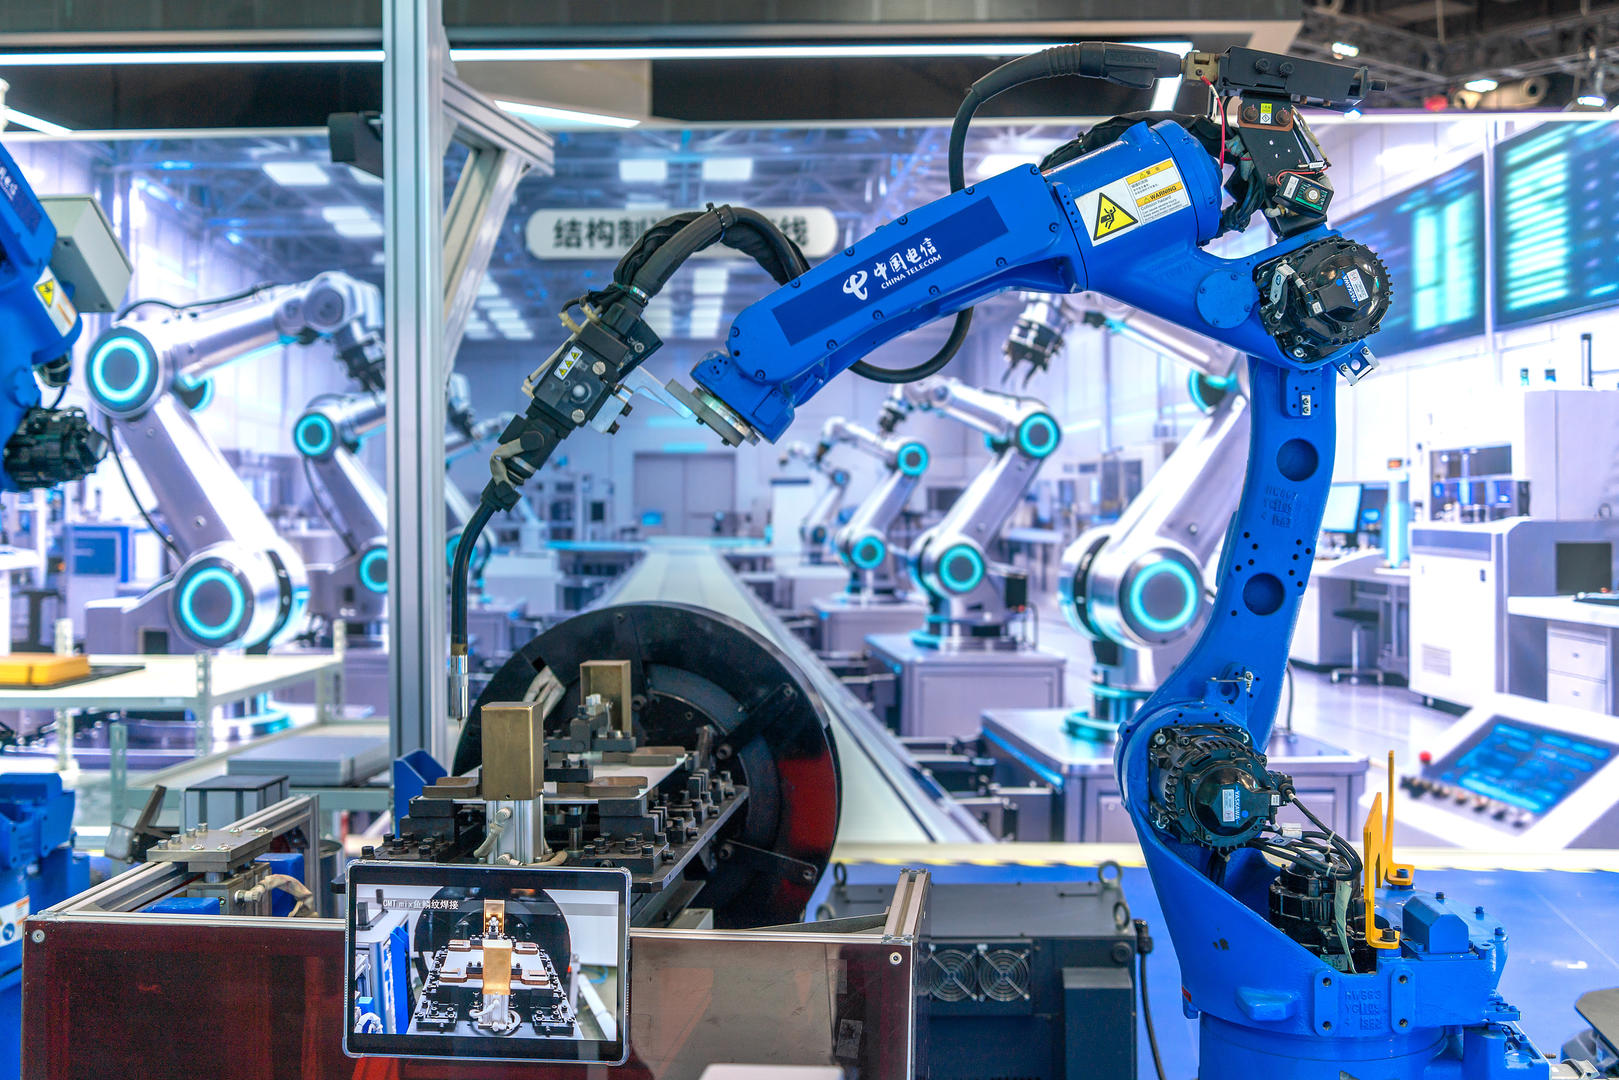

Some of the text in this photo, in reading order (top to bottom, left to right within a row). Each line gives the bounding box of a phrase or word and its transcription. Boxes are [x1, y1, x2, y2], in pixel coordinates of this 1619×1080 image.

[1150, 186, 1177, 200] WARNING
[874, 237, 937, 280] 中国电信
[881, 254, 942, 289] CHINA TELECOM
